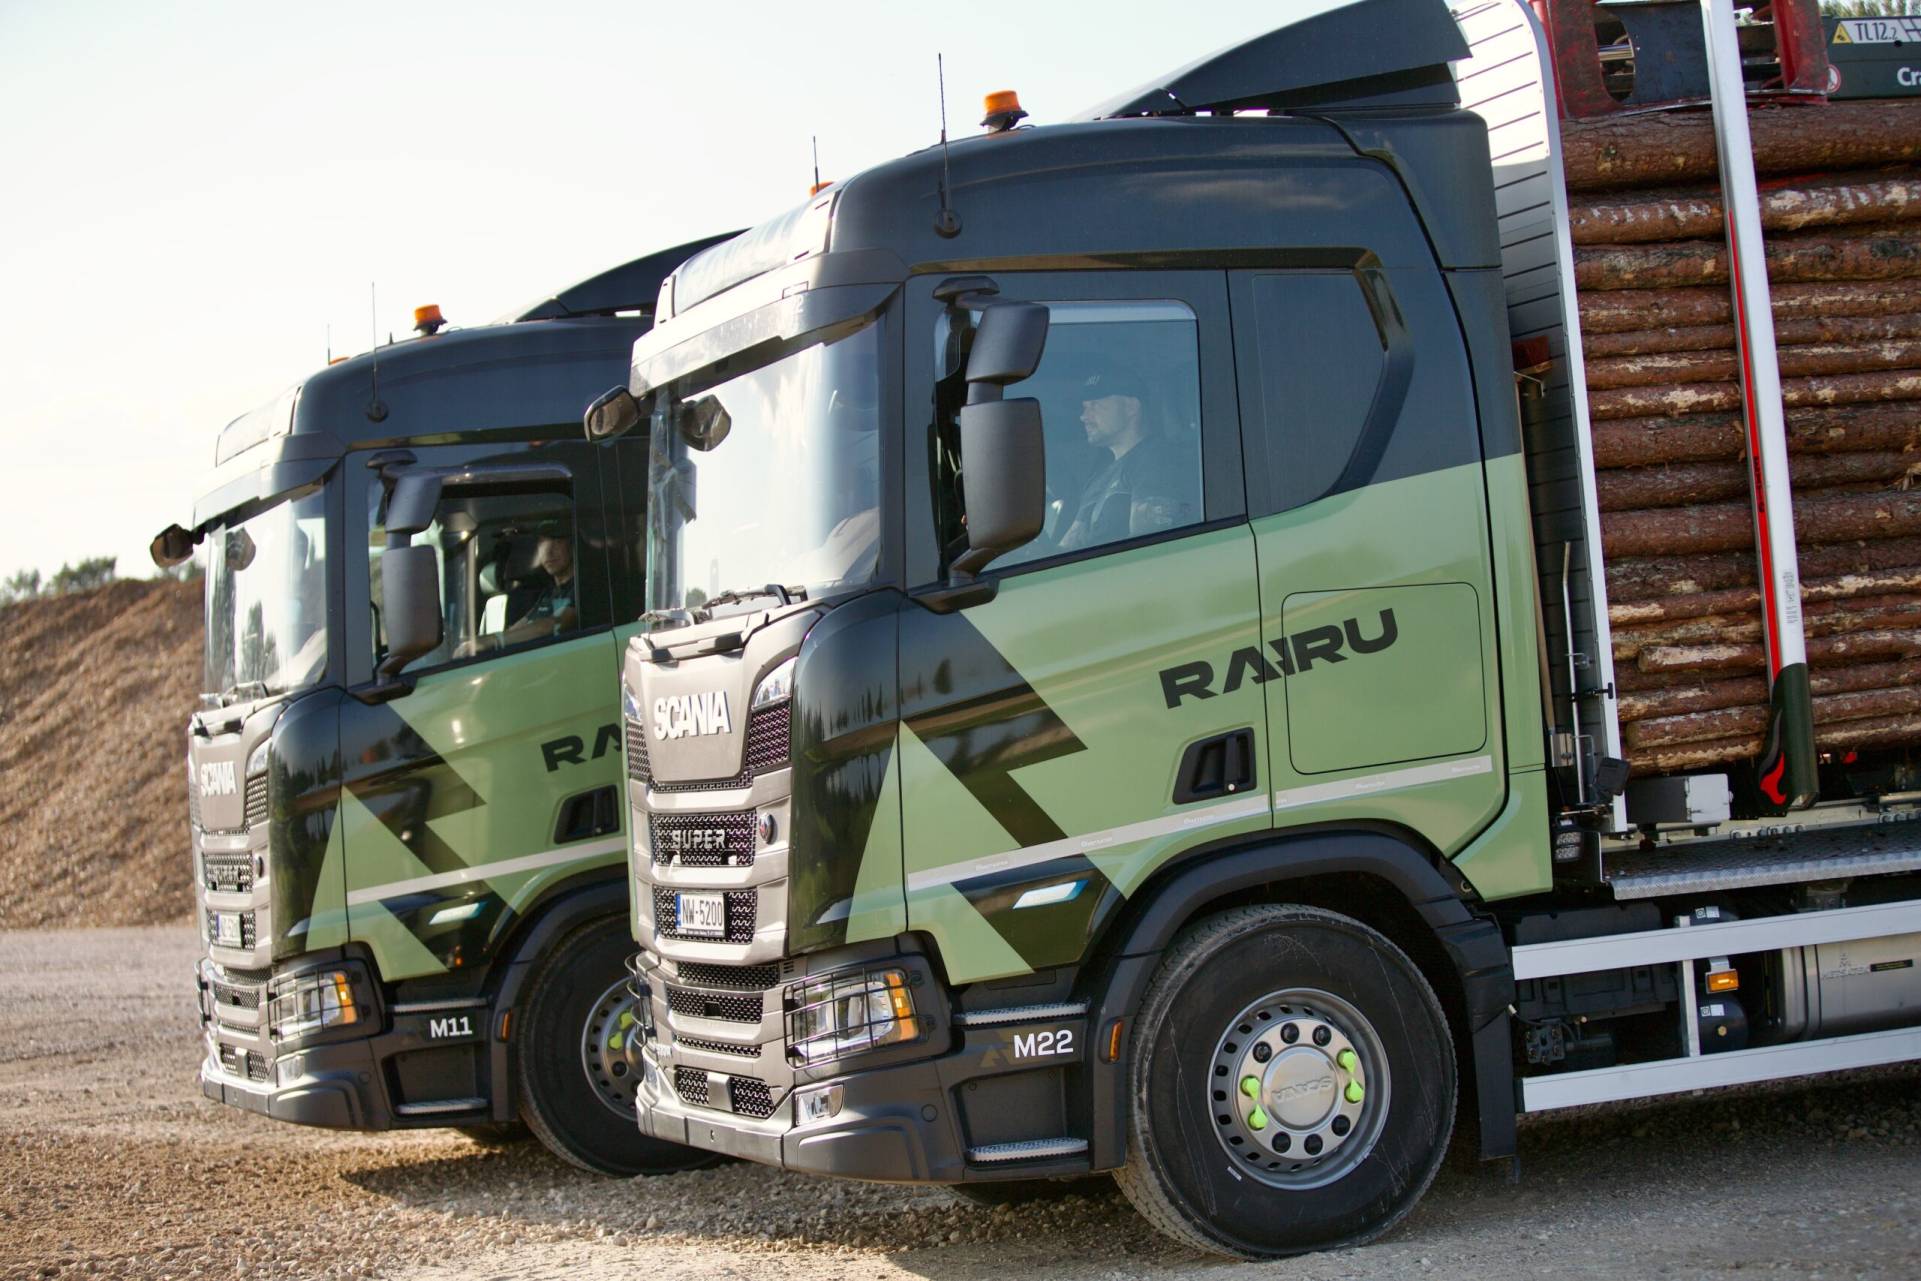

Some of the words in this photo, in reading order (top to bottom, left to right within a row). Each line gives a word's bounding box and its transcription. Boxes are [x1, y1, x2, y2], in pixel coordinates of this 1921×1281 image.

[1896, 66, 1921, 86] Cr
[1158, 608, 1398, 710] RAIRU
[653, 690, 732, 740] SCANIA
[541, 723, 622, 773] RA
[200, 760, 237, 797] SCANIA
[671, 829, 726, 849] SUPER
[430, 1016, 473, 1038] M11
[1013, 1029, 1074, 1058] M22
